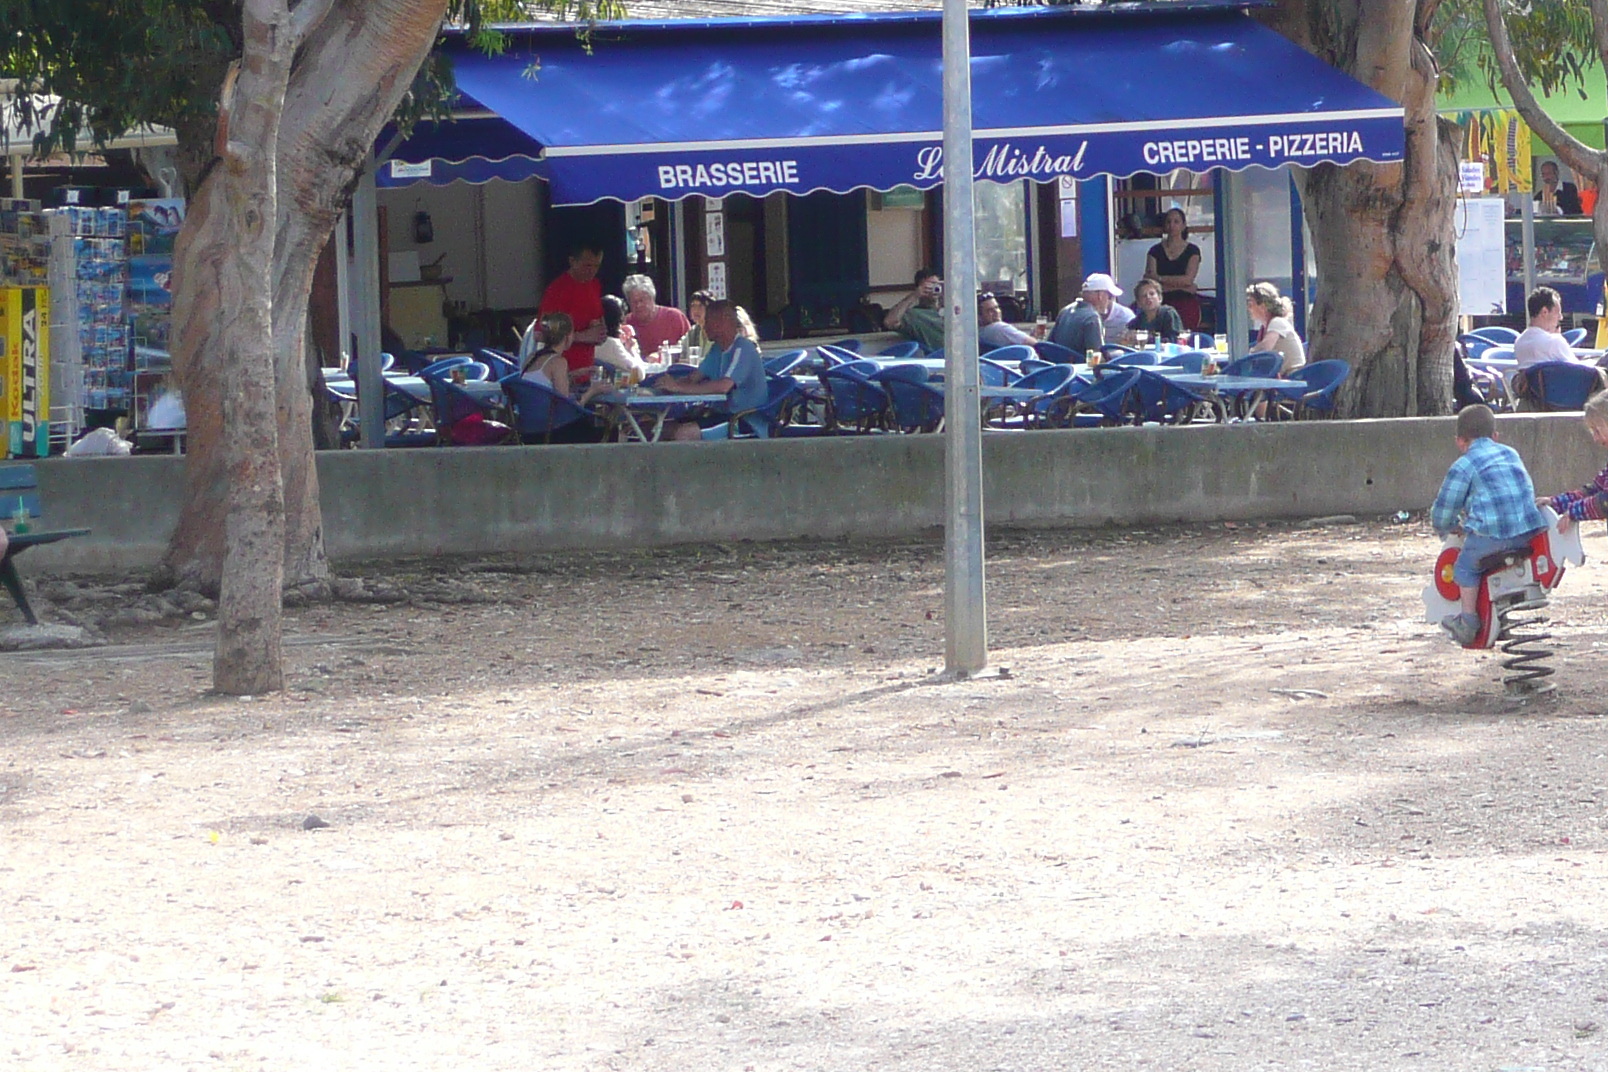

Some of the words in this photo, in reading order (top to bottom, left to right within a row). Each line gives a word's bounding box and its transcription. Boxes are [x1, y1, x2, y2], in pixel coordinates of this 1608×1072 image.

[914, 146, 944, 180] L
[972, 140, 1088, 178] Mistral
[1143, 137, 1251, 165] CREPERIE
[1269, 131, 1363, 158] PIZZERIA
[658, 160, 800, 189] BRASSERIE
[12, 344, 20, 416] Kodak
[23, 309, 35, 442] ULTRA
